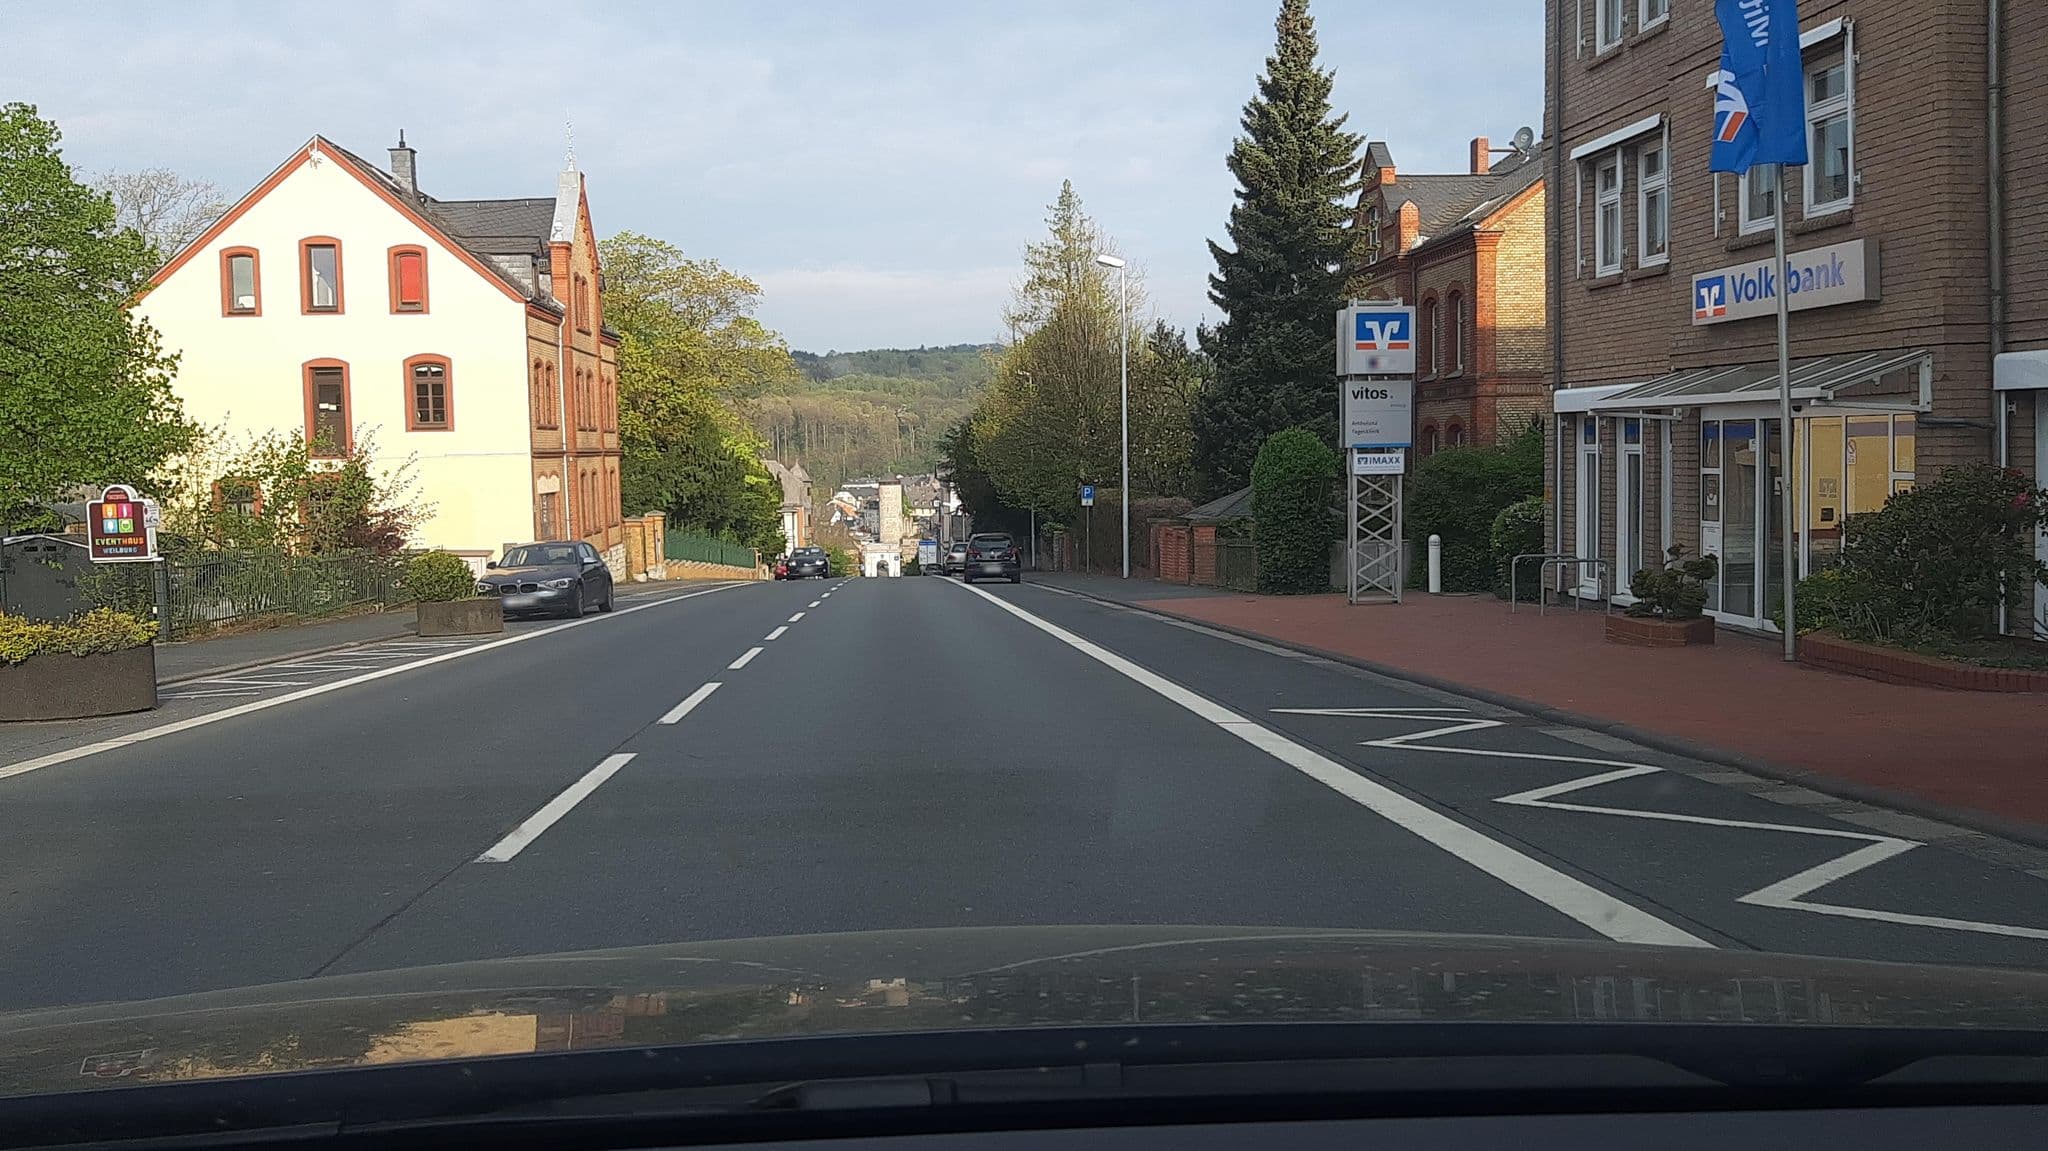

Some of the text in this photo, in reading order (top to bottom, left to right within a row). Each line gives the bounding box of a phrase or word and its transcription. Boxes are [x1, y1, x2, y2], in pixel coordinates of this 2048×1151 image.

[1731, 252, 1845, 304] Volkbank
[1084, 487, 1091, 497] P
[95, 537, 144, 545] EVENTHAUS
